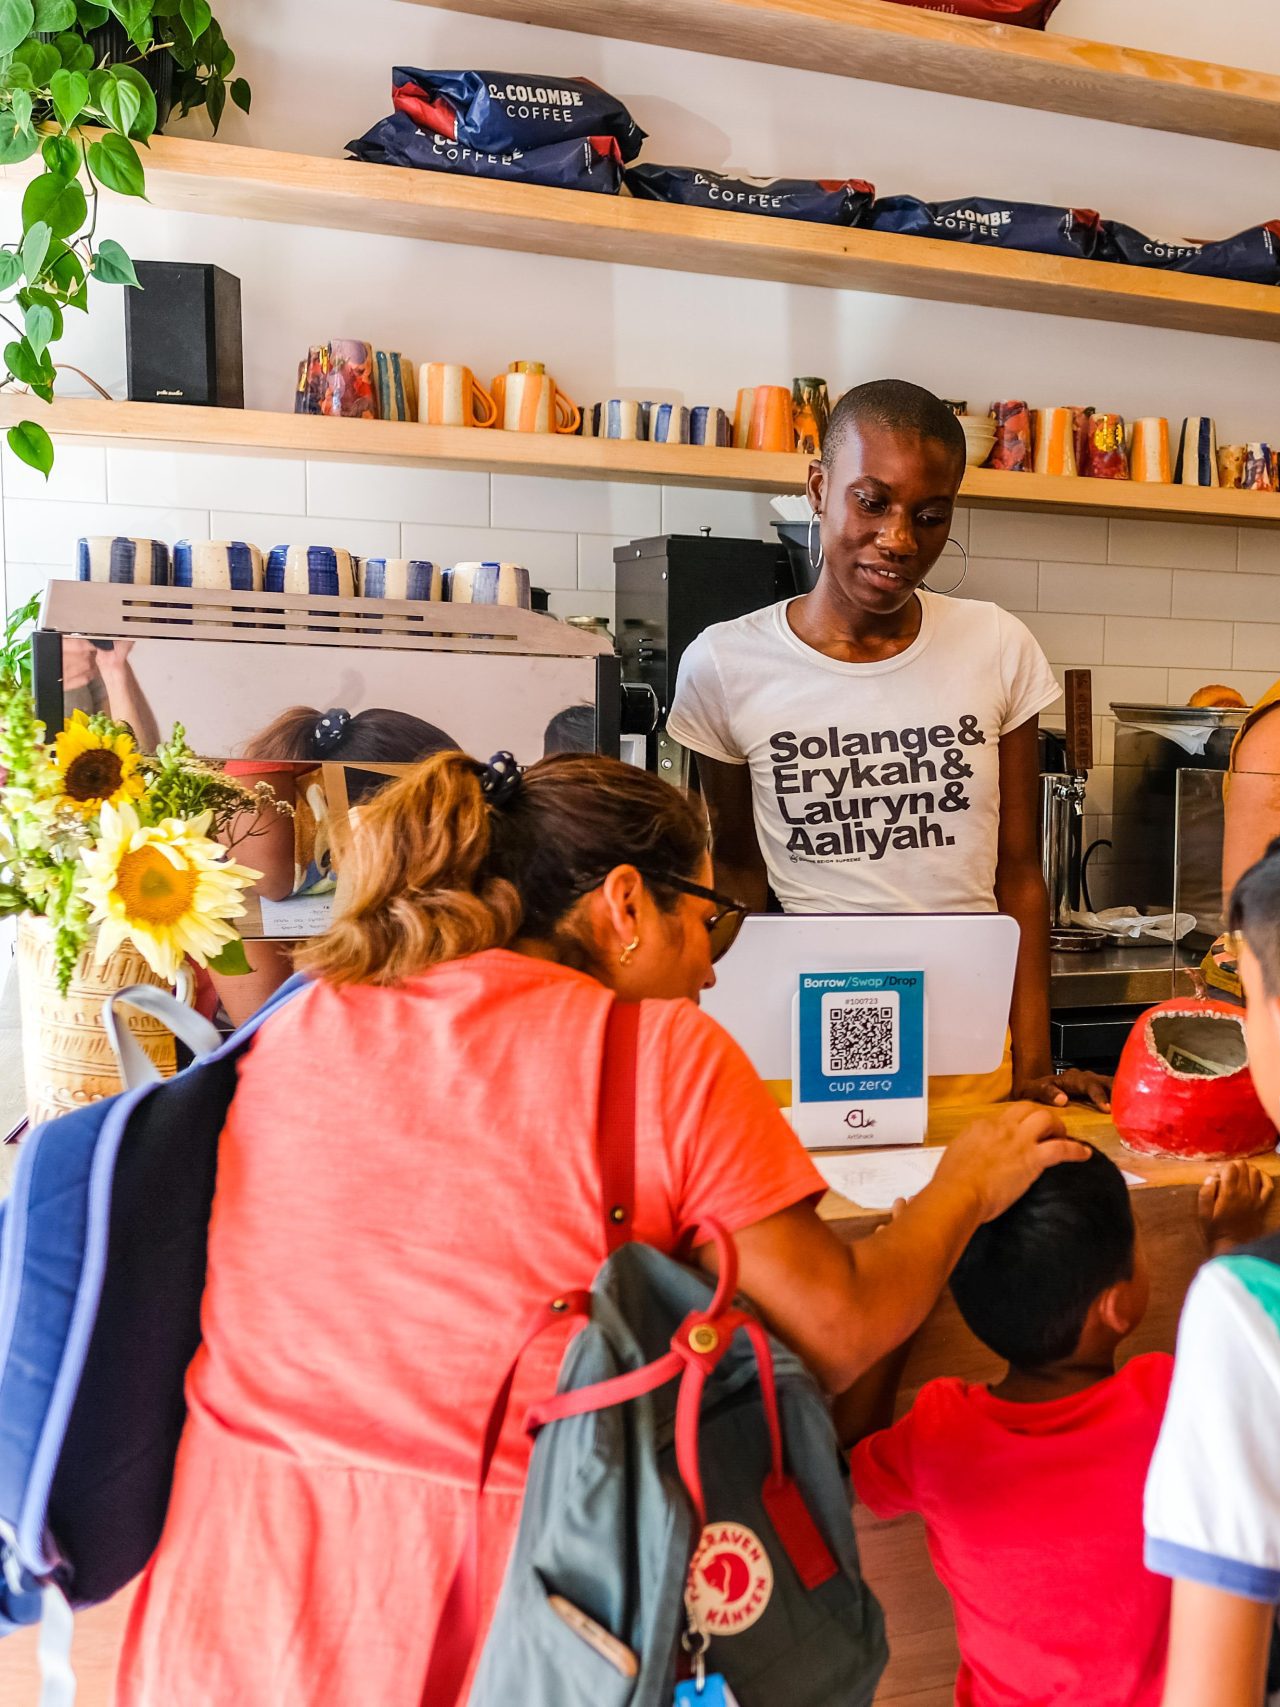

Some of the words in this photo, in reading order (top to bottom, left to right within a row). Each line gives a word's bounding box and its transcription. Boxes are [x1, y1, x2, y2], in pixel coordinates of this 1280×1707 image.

[488, 83, 505, 100] La
[505, 84, 583, 107] COLOMBE
[506, 104, 573, 123] COFFEE
[708, 187, 781, 208] COFFEE
[933, 216, 999, 237] COFFEE
[947, 208, 1012, 226] LOMBE
[769, 714, 987, 763] Solange&
[772, 748, 974, 798] Erykah&
[777, 781, 971, 825] Lauryn&
[786, 816, 956, 861] Aaliyah.
[828, 1081, 855, 1094] cup
[859, 1079, 892, 1091] zero
